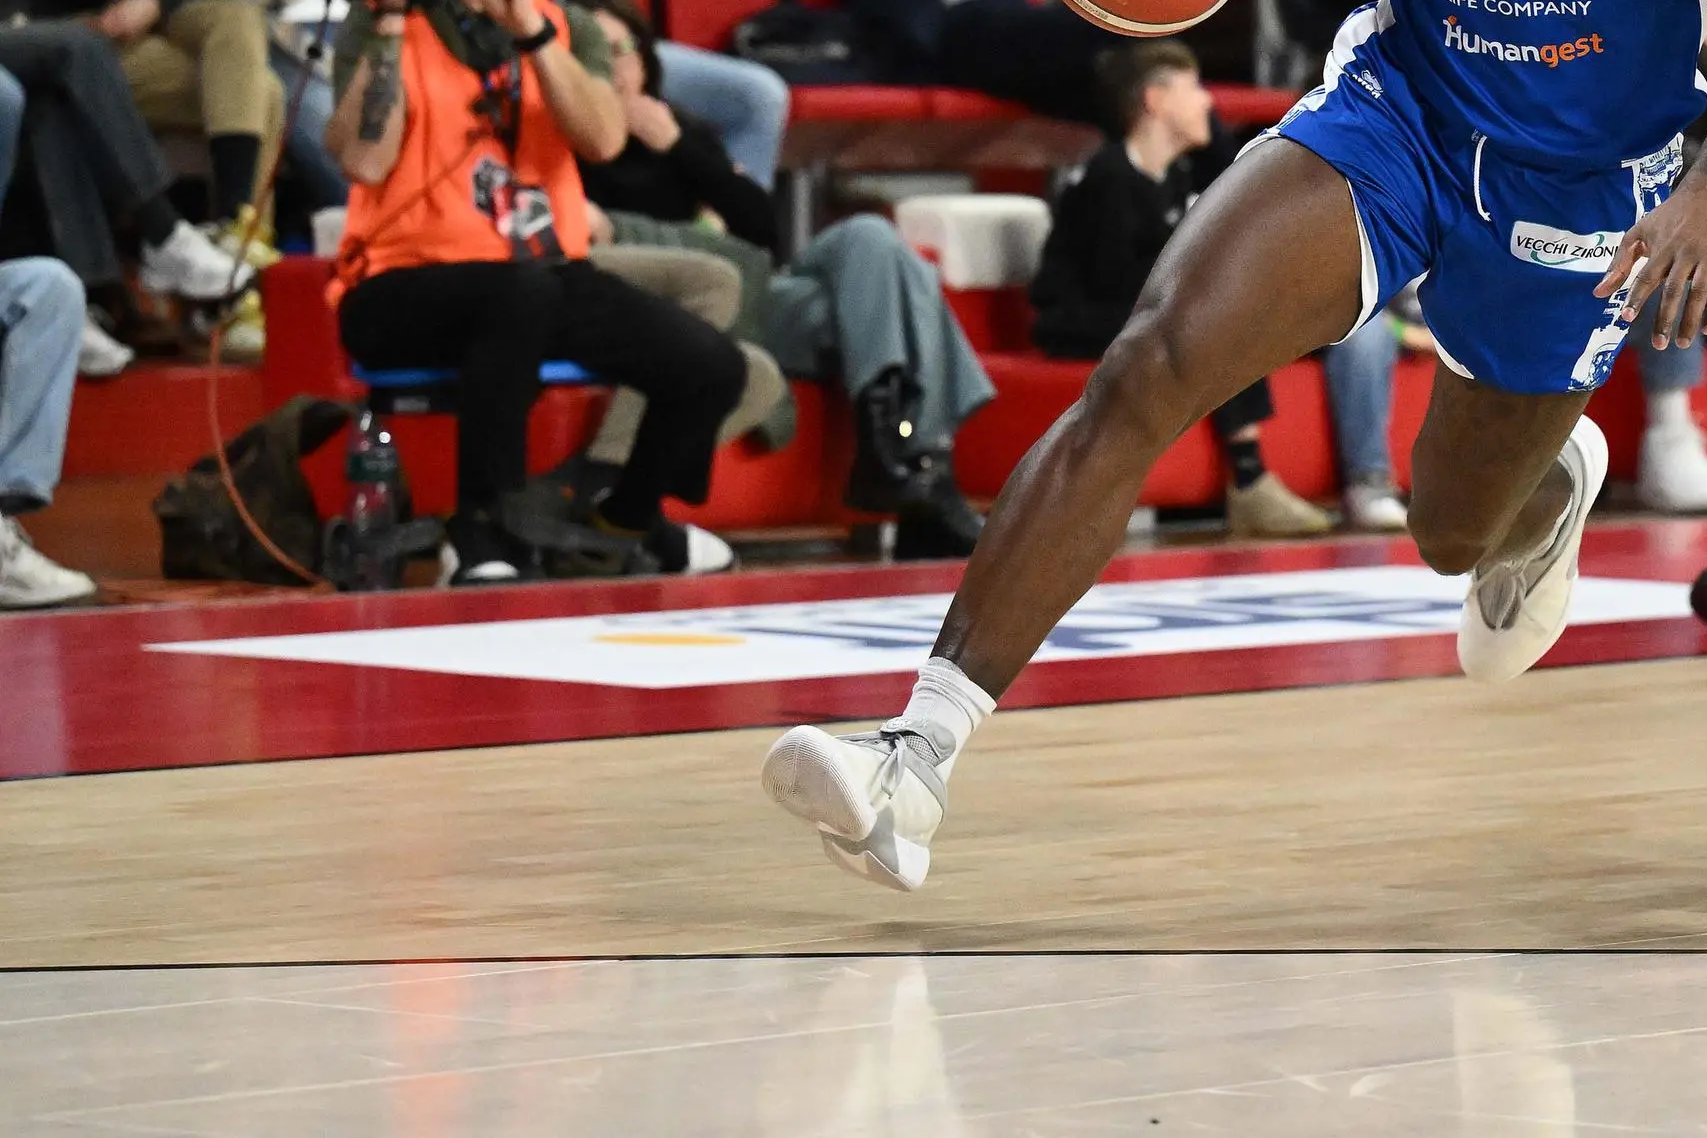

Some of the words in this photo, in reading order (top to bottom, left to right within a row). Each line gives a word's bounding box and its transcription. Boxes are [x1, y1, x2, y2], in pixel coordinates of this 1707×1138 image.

[1443, 17, 1605, 68] Humangest
[1516, 235, 1568, 254] VECCHI
[1571, 245, 1618, 259] ZIRONI
